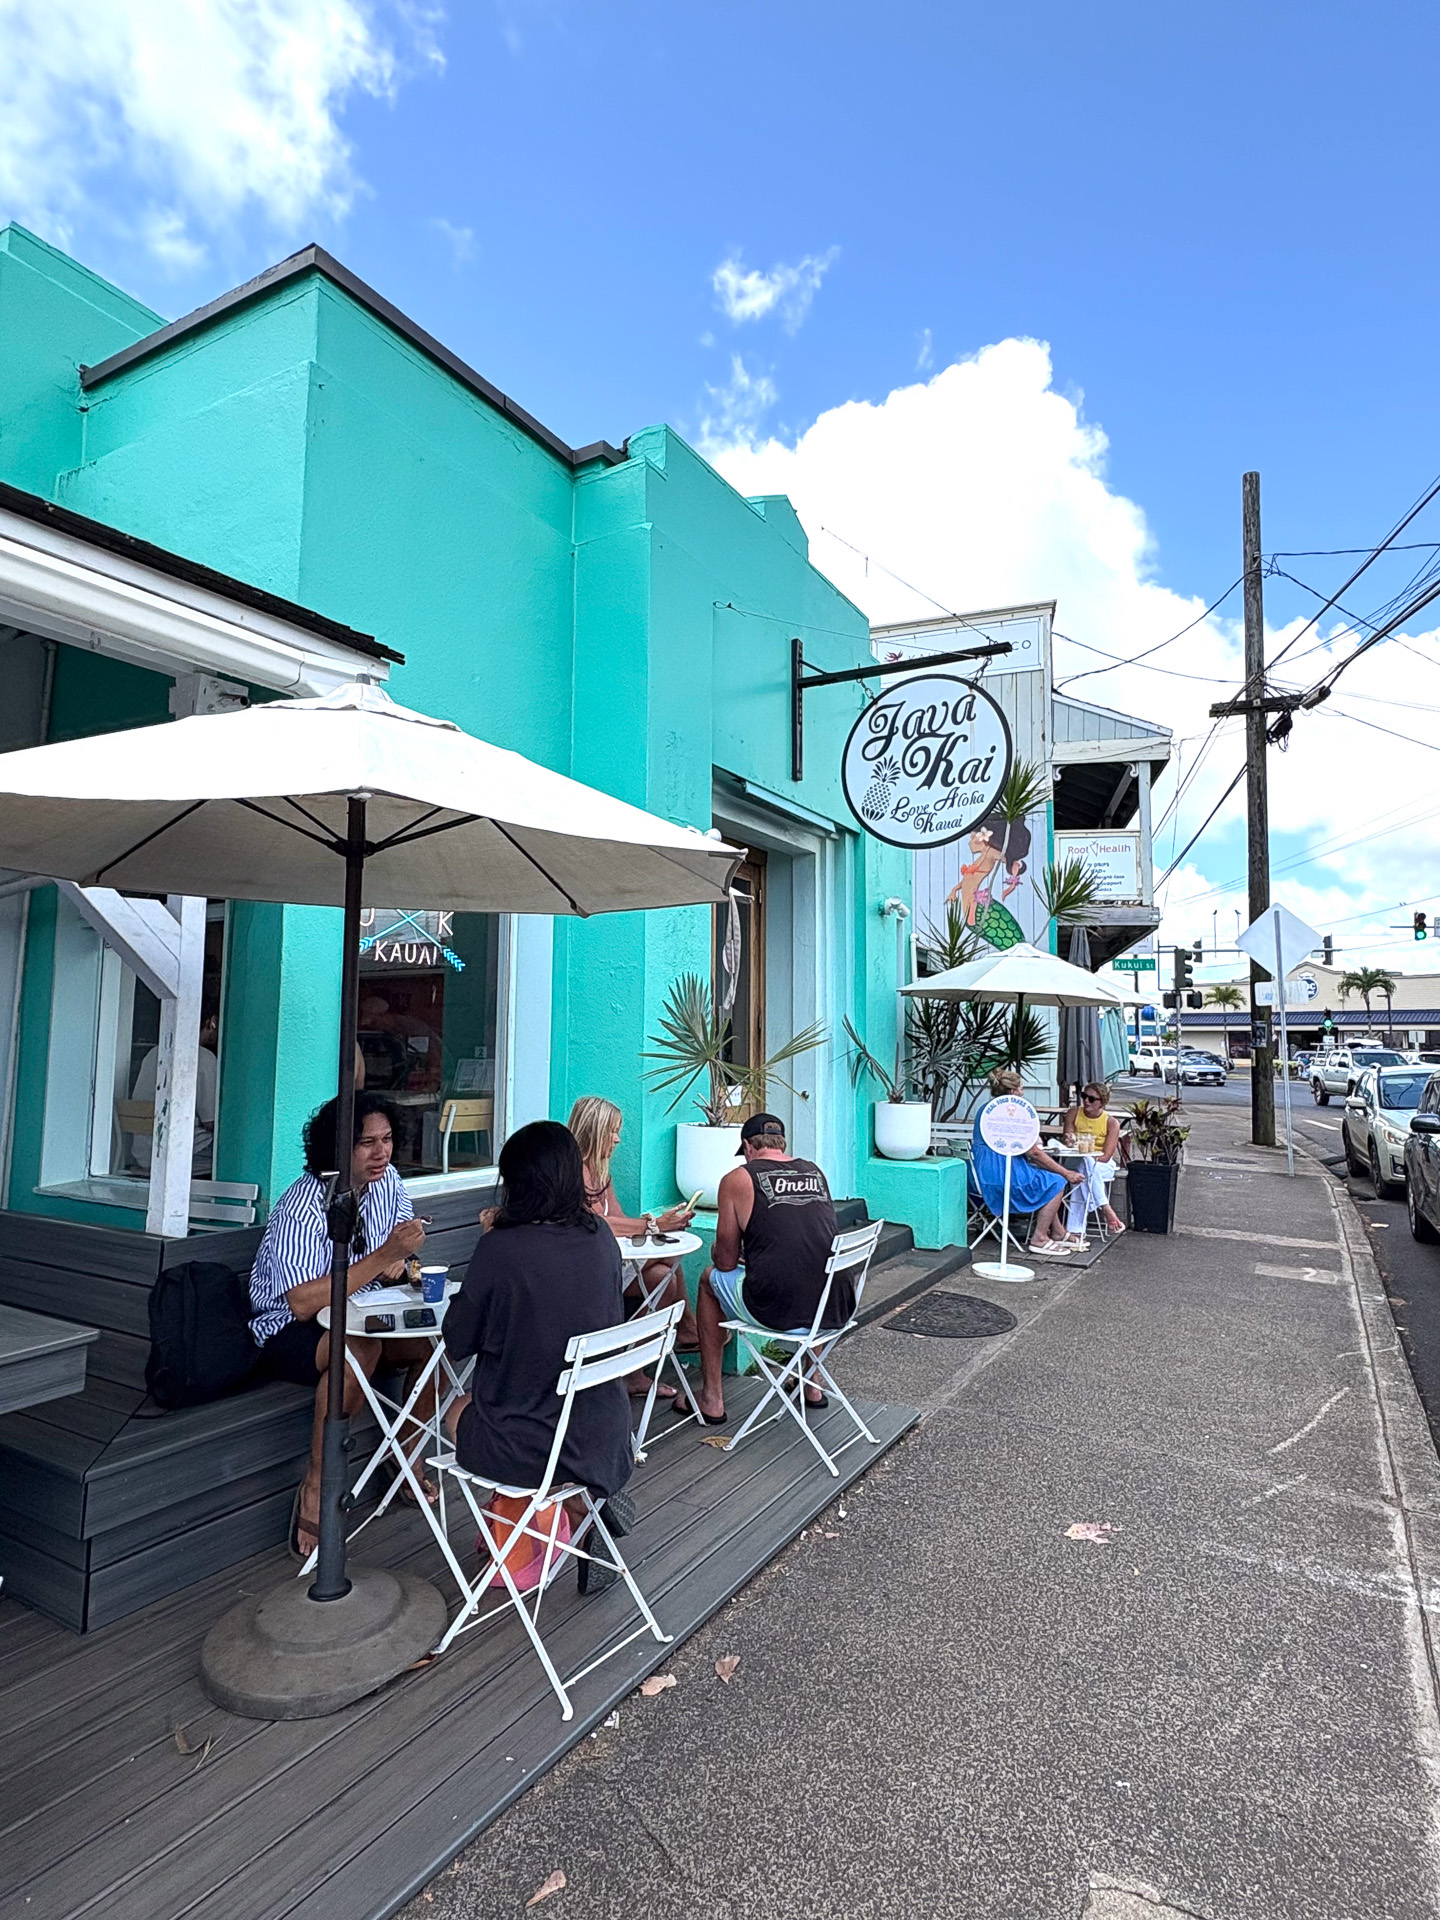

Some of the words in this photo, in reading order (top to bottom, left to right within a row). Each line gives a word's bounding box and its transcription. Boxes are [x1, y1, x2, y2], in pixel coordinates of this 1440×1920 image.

[861, 694, 977, 761] Java
[901, 731, 997, 791] Kai
[889, 796, 930, 823] Love
[933, 786, 985, 812] Aloha
[913, 812, 963, 834] Kauai
[1067, 845, 1089, 855] Root
[1099, 844, 1131, 853] Health
[374, 940, 437, 965] KAUAI
[1114, 960, 1143, 969] Kukui
